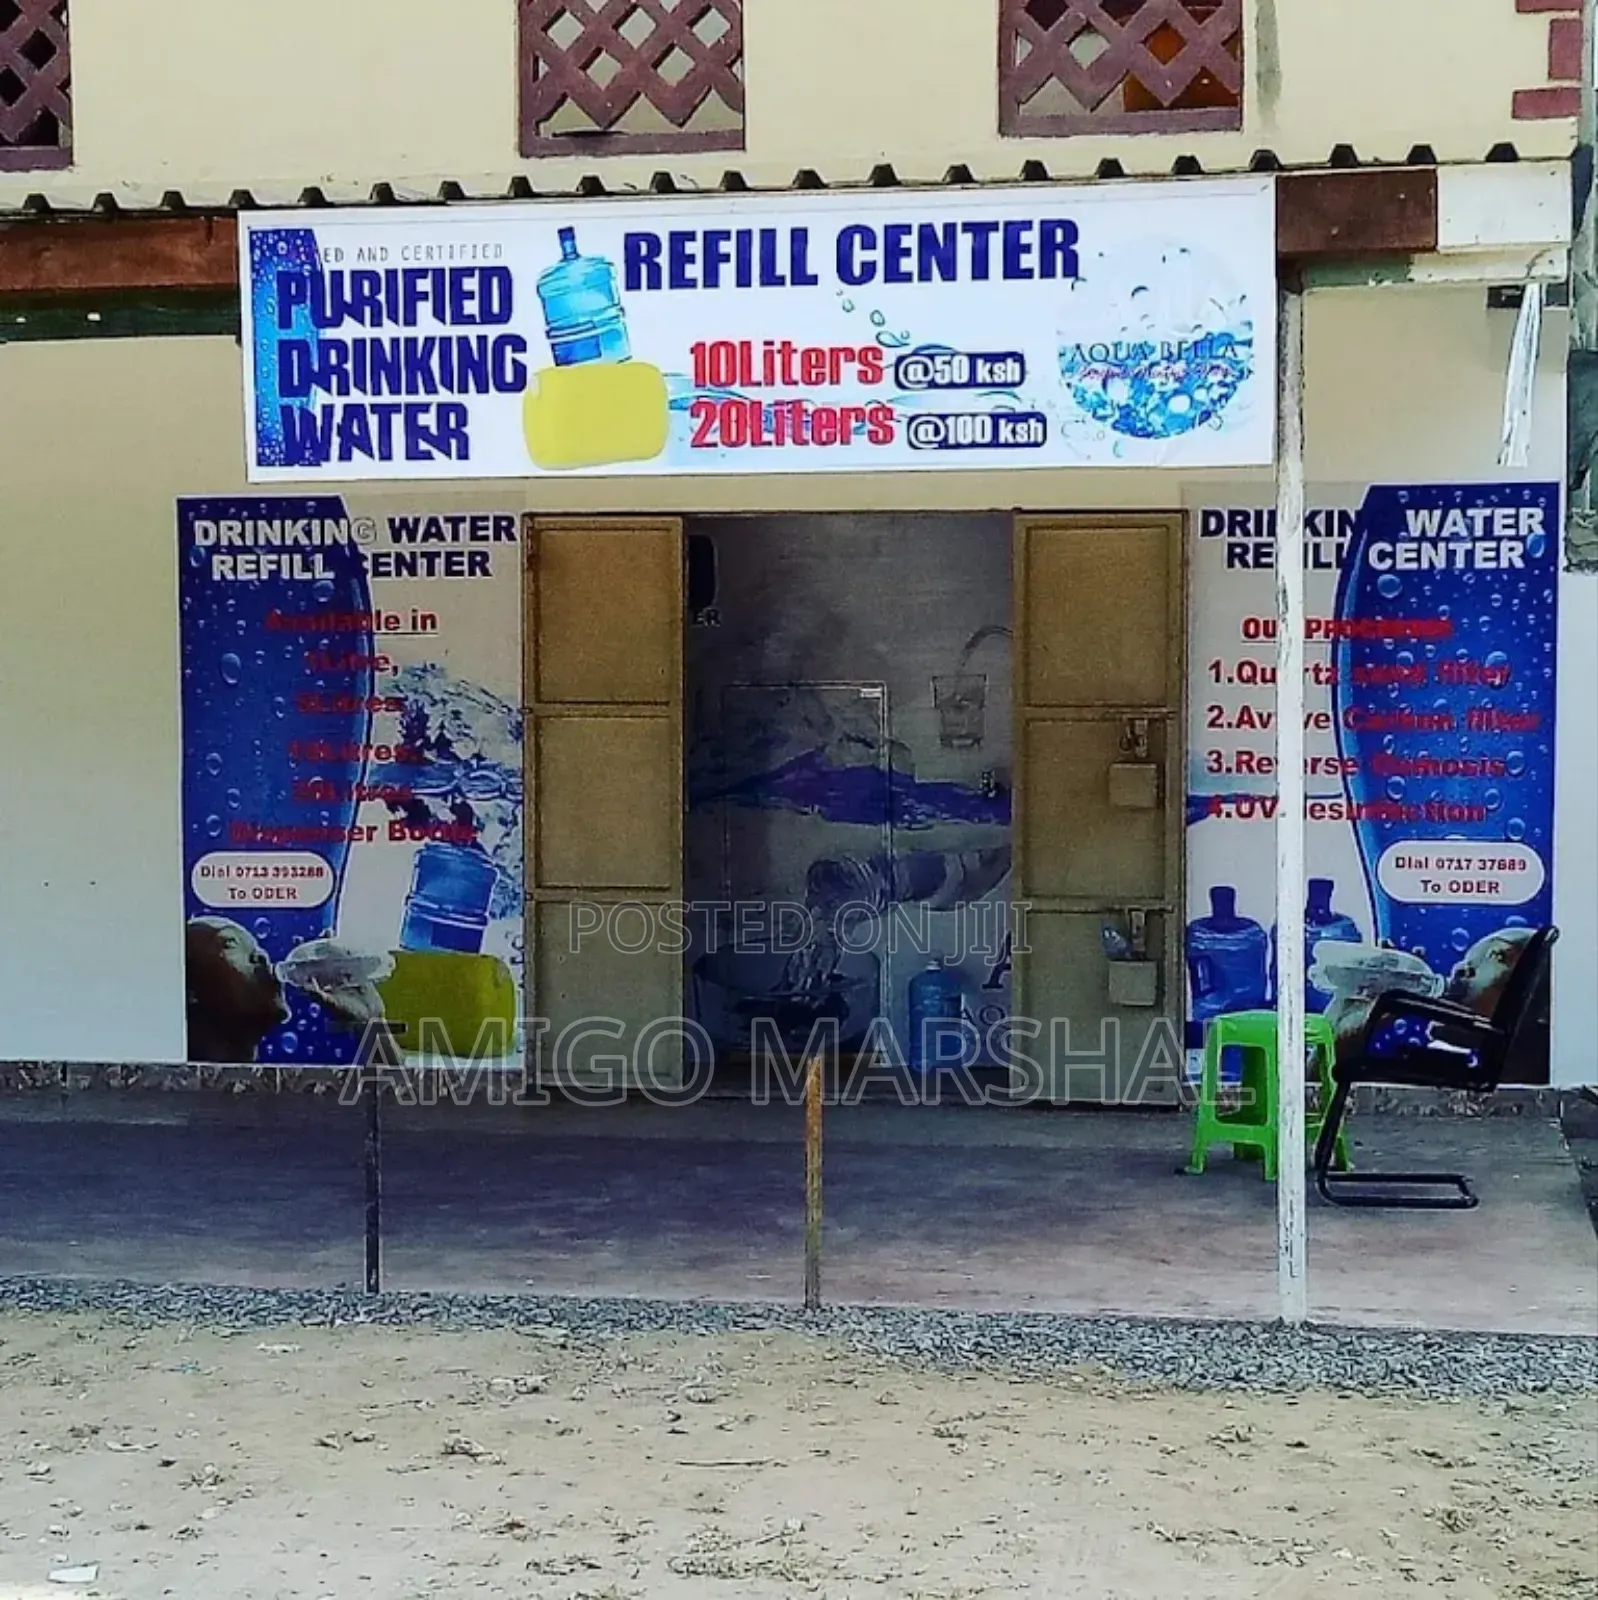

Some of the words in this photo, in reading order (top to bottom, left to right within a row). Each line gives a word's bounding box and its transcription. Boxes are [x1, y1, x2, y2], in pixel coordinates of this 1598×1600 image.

[356, 247, 389, 262] AND
[401, 243, 503, 261] CERTIFIED
[624, 228, 819, 291] REFILL
[836, 218, 1079, 286] CENTER
[276, 266, 513, 330] PURIFIED
[277, 334, 528, 398] DRINKING
[689, 340, 883, 389] 10Liters
[898, 354, 969, 389] @50
[975, 353, 1021, 386] ksh
[1070, 340, 1149, 364] AQUA
[281, 401, 470, 468] WATER
[689, 400, 895, 448] 20Liters
[908, 416, 989, 447] @100
[996, 414, 1045, 446] ksh
[194, 518, 377, 547] DRINKING
[387, 514, 517, 545] WATER
[1405, 507, 1545, 538] WATER
[212, 553, 335, 581] REFILL
[362, 550, 493, 578] ENTER
[1368, 540, 1525, 570] CENTER
[411, 608, 437, 631] in
[1208, 660, 1338, 688] 1.Qurtz
[1395, 857, 1429, 870] Dial
[1435, 857, 1472, 871] 0717
[228, 887, 248, 901] To
[1421, 880, 1441, 894] To
[1448, 881, 1500, 895] ODER
